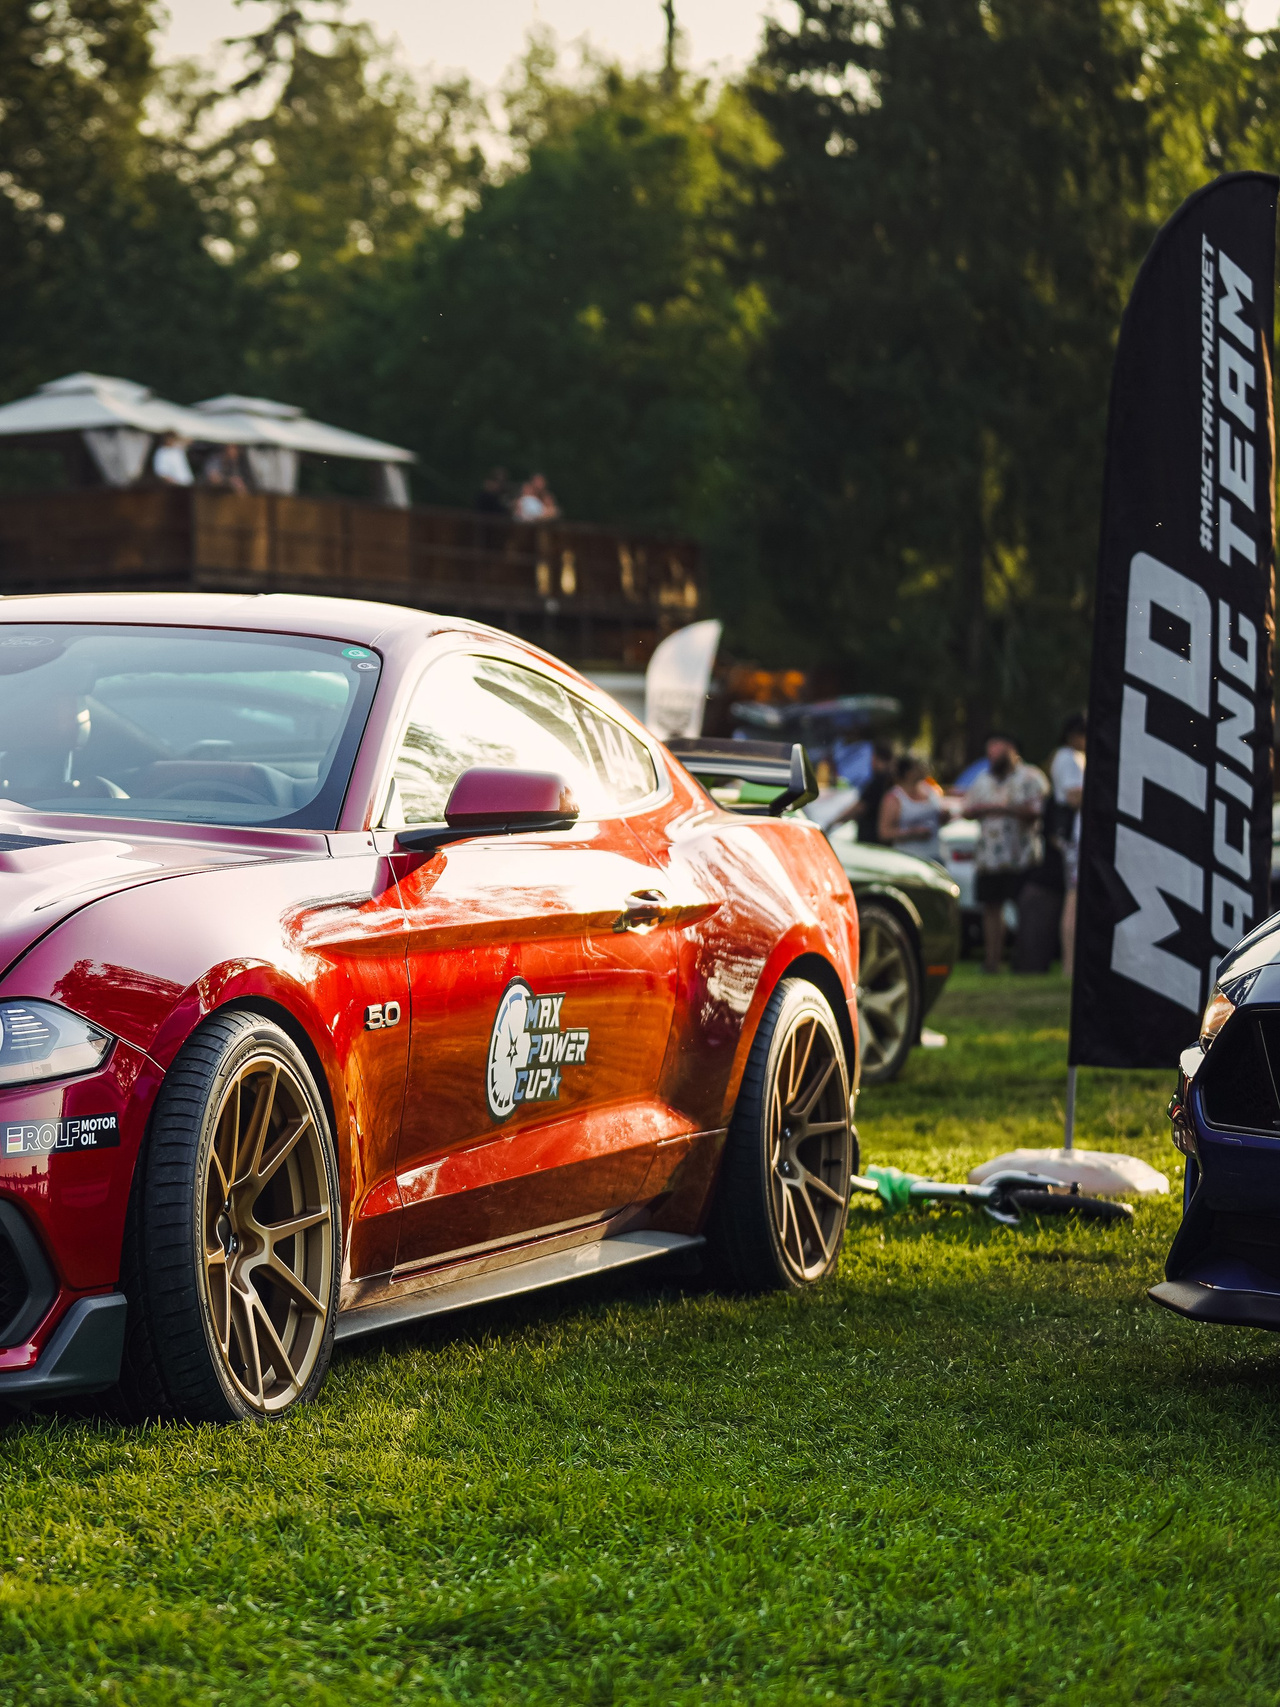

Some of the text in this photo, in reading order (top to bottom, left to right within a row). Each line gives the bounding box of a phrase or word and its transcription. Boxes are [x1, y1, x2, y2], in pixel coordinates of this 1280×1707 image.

[1199, 233, 1217, 552] #МУСТАНГМОЖЕТ
[1207, 249, 1258, 990] ACING TEAM
[1110, 550, 1212, 1014] MTD
[525, 997, 564, 1028] MAX
[528, 1032, 589, 1064] POWER
[514, 1069, 551, 1101] CUP
[21, 1117, 117, 1150] ROLF MOTOR
[81, 1132, 97, 1146] OIL
